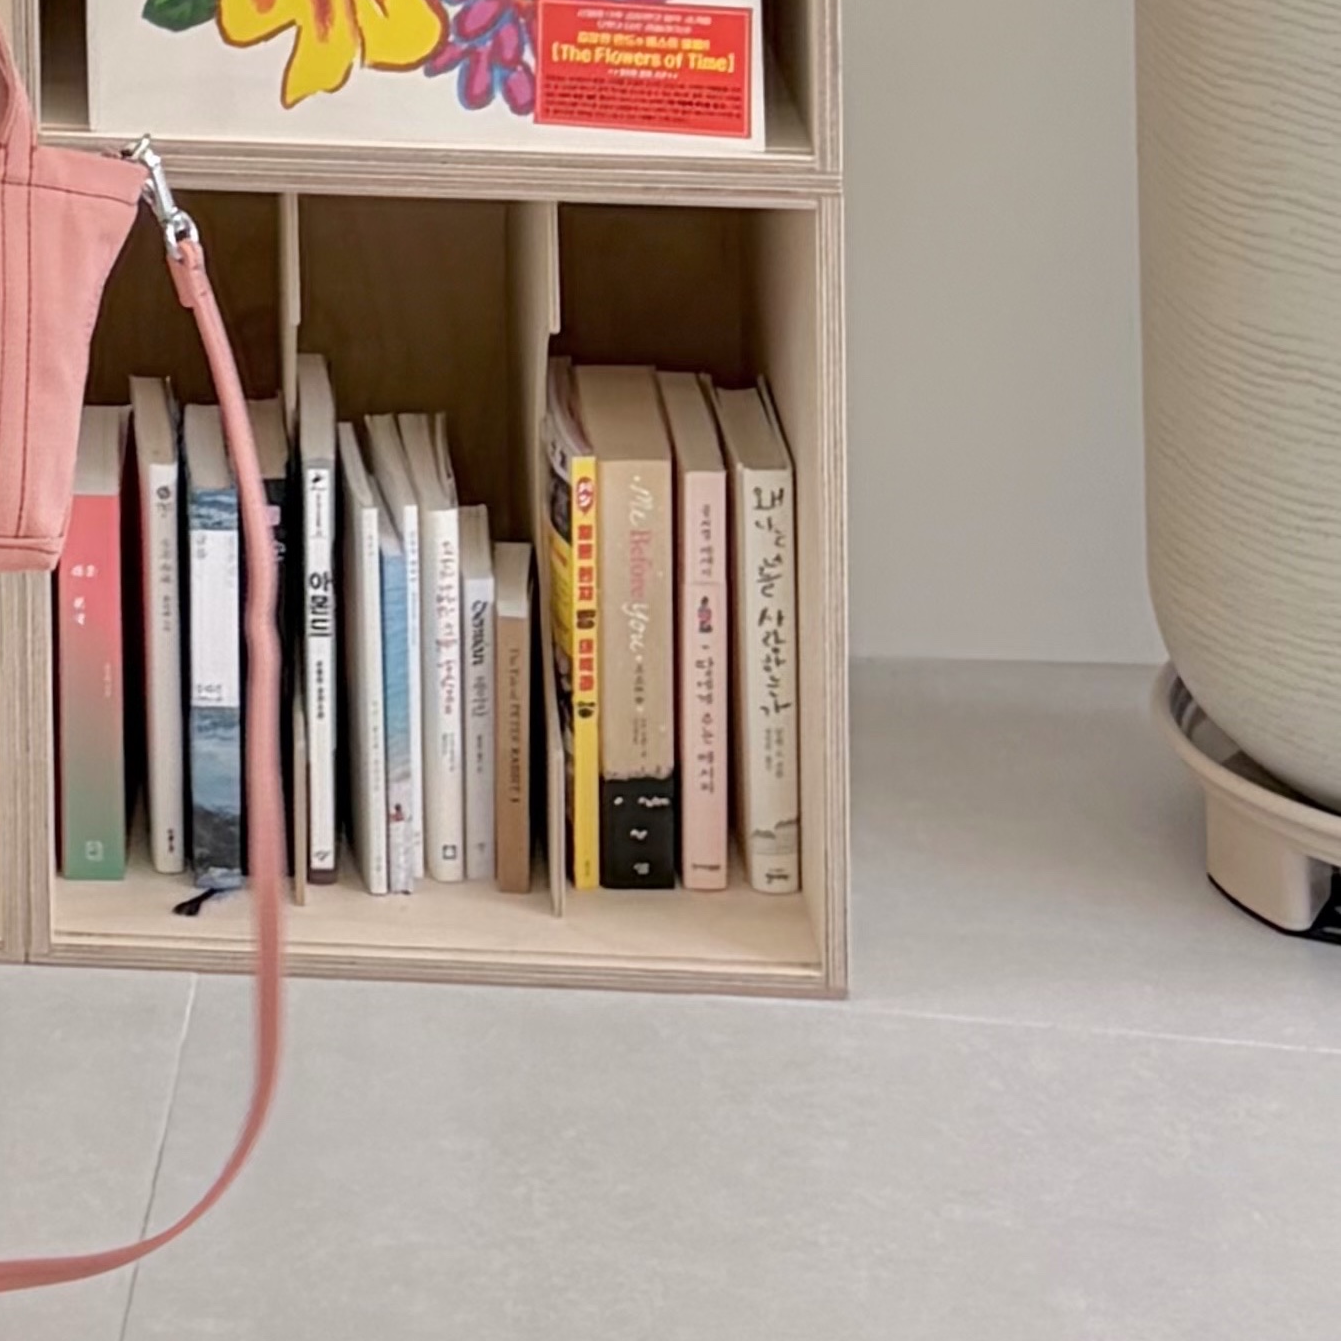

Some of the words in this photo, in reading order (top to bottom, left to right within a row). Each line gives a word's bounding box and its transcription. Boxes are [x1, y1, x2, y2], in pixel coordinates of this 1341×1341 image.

[594, 45, 662, 69] Flowers
[664, 51, 684, 69] of
[627, 484, 654, 526] Me
[629, 529, 651, 595] Before
[621, 602, 650, 652] You
